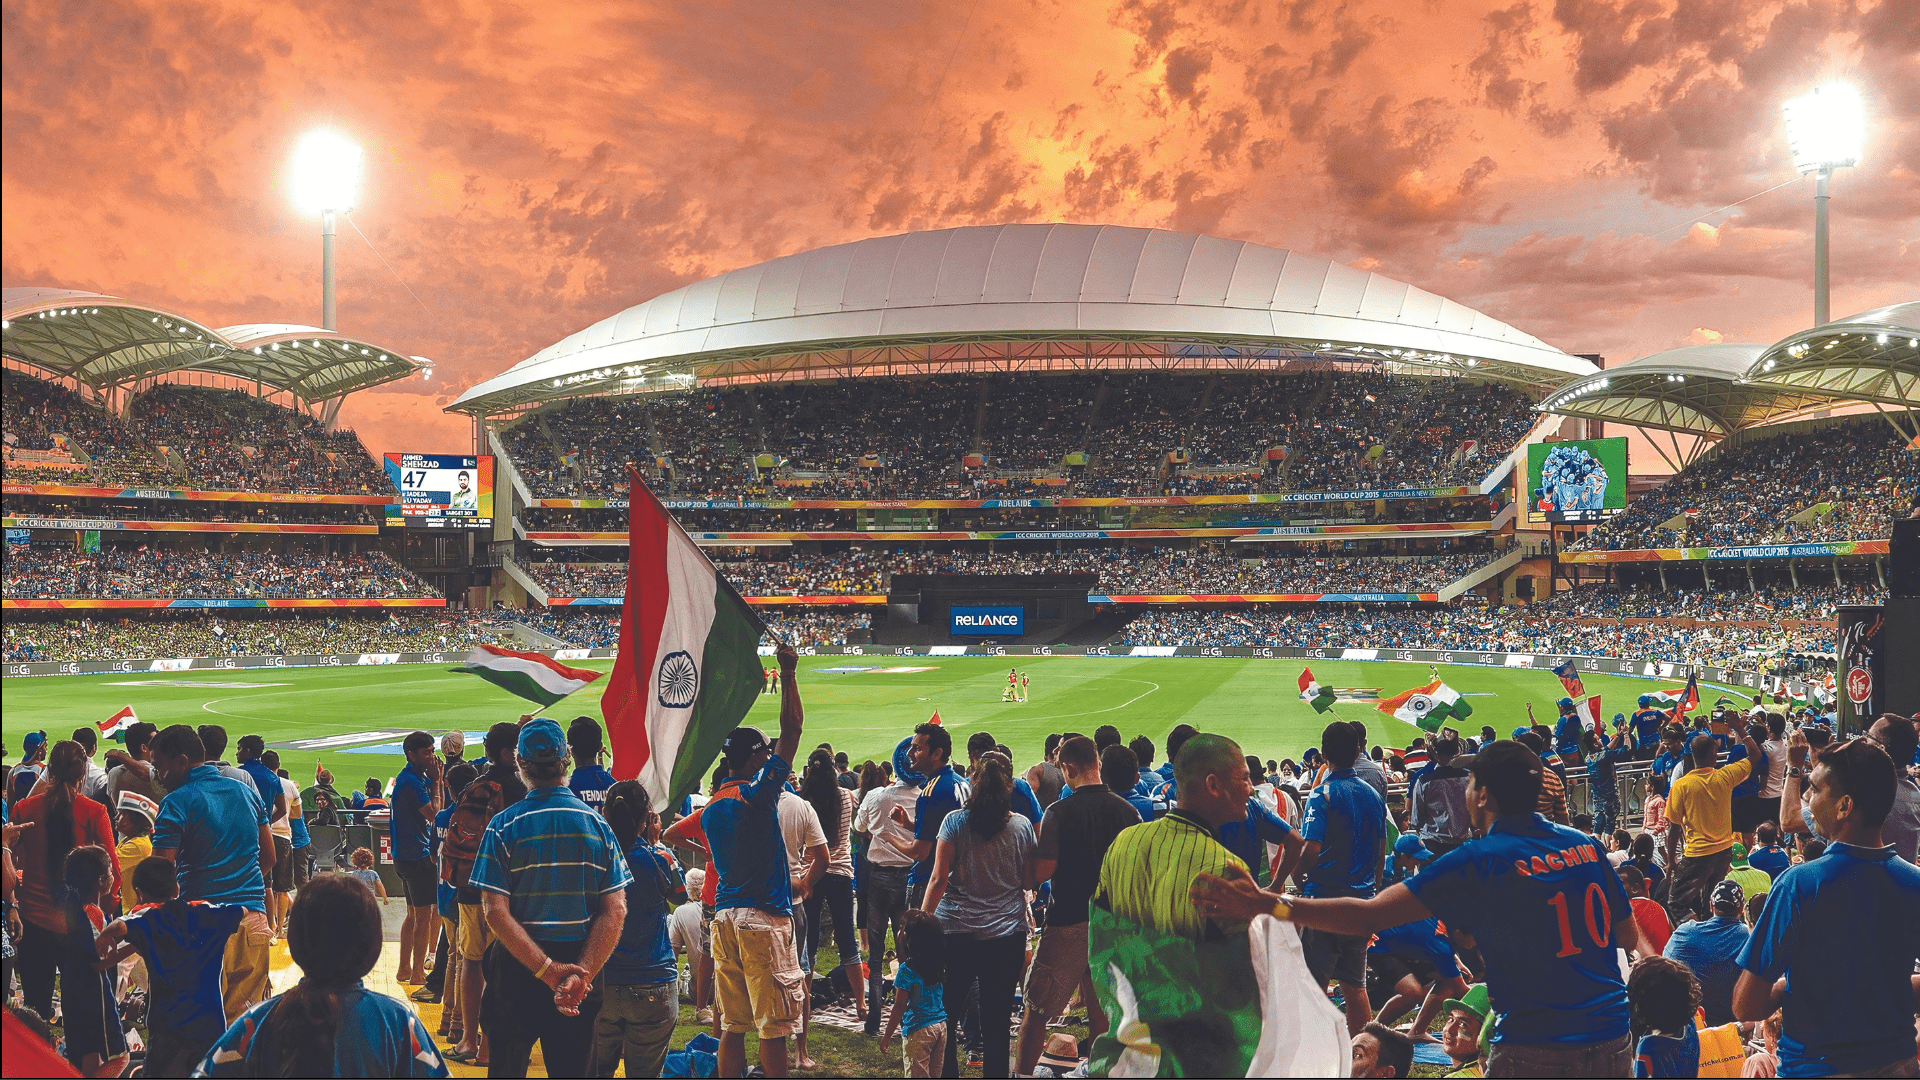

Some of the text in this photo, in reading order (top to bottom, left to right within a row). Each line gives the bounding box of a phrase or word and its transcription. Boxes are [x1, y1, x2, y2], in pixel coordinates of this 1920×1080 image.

[403, 471, 427, 488] 47
[136, 490, 170, 499] AUSTRALIA
[1293, 493, 1322, 501] CRICKET
[605, 500, 617, 508] ICC
[29, 520, 58, 528] CRICKET
[1273, 527, 1310, 535] AUSTRALIA
[1707, 550, 1717, 558] ICC
[1742, 548, 1764, 557] WORLD
[1764, 547, 1776, 556] CUP
[1776, 547, 1789, 556] 2015
[1791, 546, 1816, 555] AUSTRALIA
[1819, 546, 1829, 554] NEW
[955, 614, 1018, 626] RELIANCE
[796, 646, 804, 655] LG
[843, 646, 851, 654] LG
[895, 647, 902, 655] LG
[987, 647, 995, 655] LG
[1086, 646, 1110, 655] LG G3
[1210, 647, 1222, 656] G3
[1253, 647, 1273, 656] LG G3
[1306, 648, 1325, 657] LG G3
[329, 655, 340, 665] G3
[423, 654, 431, 662] LG
[1396, 651, 1403, 660] LG
[1437, 653, 1444, 661] LG
[1478, 654, 1485, 662] LG
[112, 661, 132, 671] LG G3
[215, 658, 235, 667] LG G3
[265, 658, 273, 666] LG
[1549, 658, 1556, 666] LG
[1584, 660, 1591, 668] LG
[1619, 662, 1626, 671] LG
[10, 664, 30, 675] LG G3
[59, 664, 67, 672] LG
[1515, 844, 1598, 876] SACHIN
[1548, 883, 1611, 957] 10
